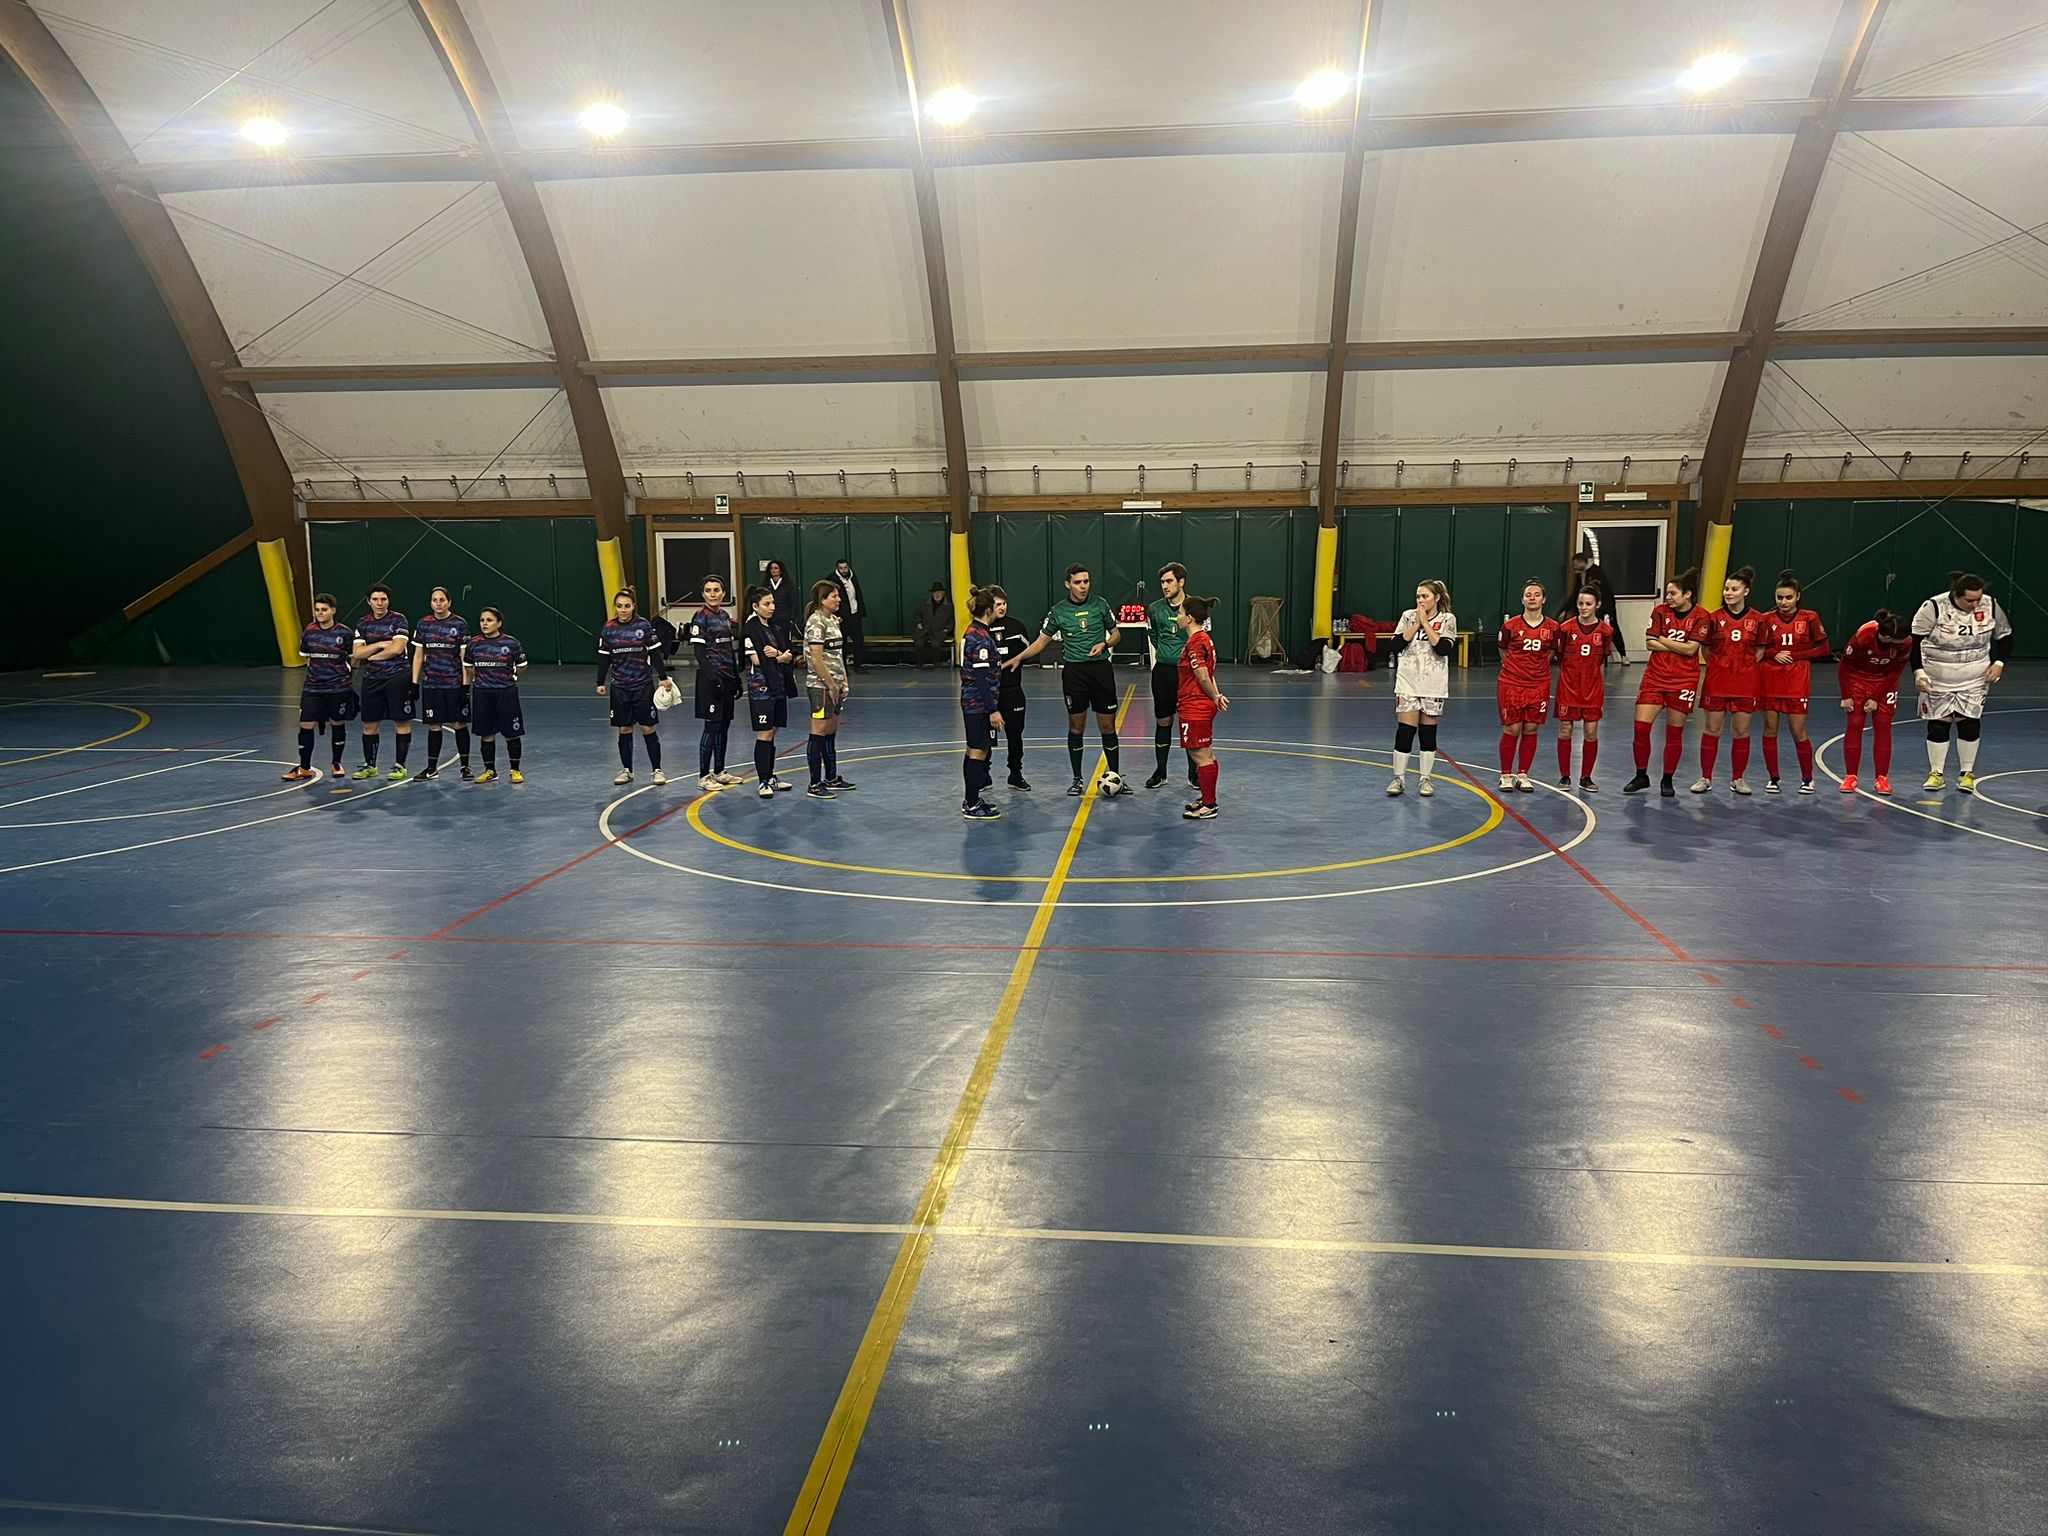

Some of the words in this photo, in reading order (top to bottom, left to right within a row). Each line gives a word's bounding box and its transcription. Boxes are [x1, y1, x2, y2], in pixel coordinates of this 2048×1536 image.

[1415, 630, 1429, 641] 12
[1667, 628, 1686, 642] 22
[1731, 629, 1741, 641] 8
[1958, 625, 1973, 636] 21
[1523, 638, 1541, 651] 29
[1781, 633, 1793, 646] 11
[1581, 644, 1591, 656] 9
[1678, 689, 1695, 702] 22
[709, 705, 715, 713] 6
[758, 715, 767, 724] 22
[1181, 723, 1189, 736] 7
